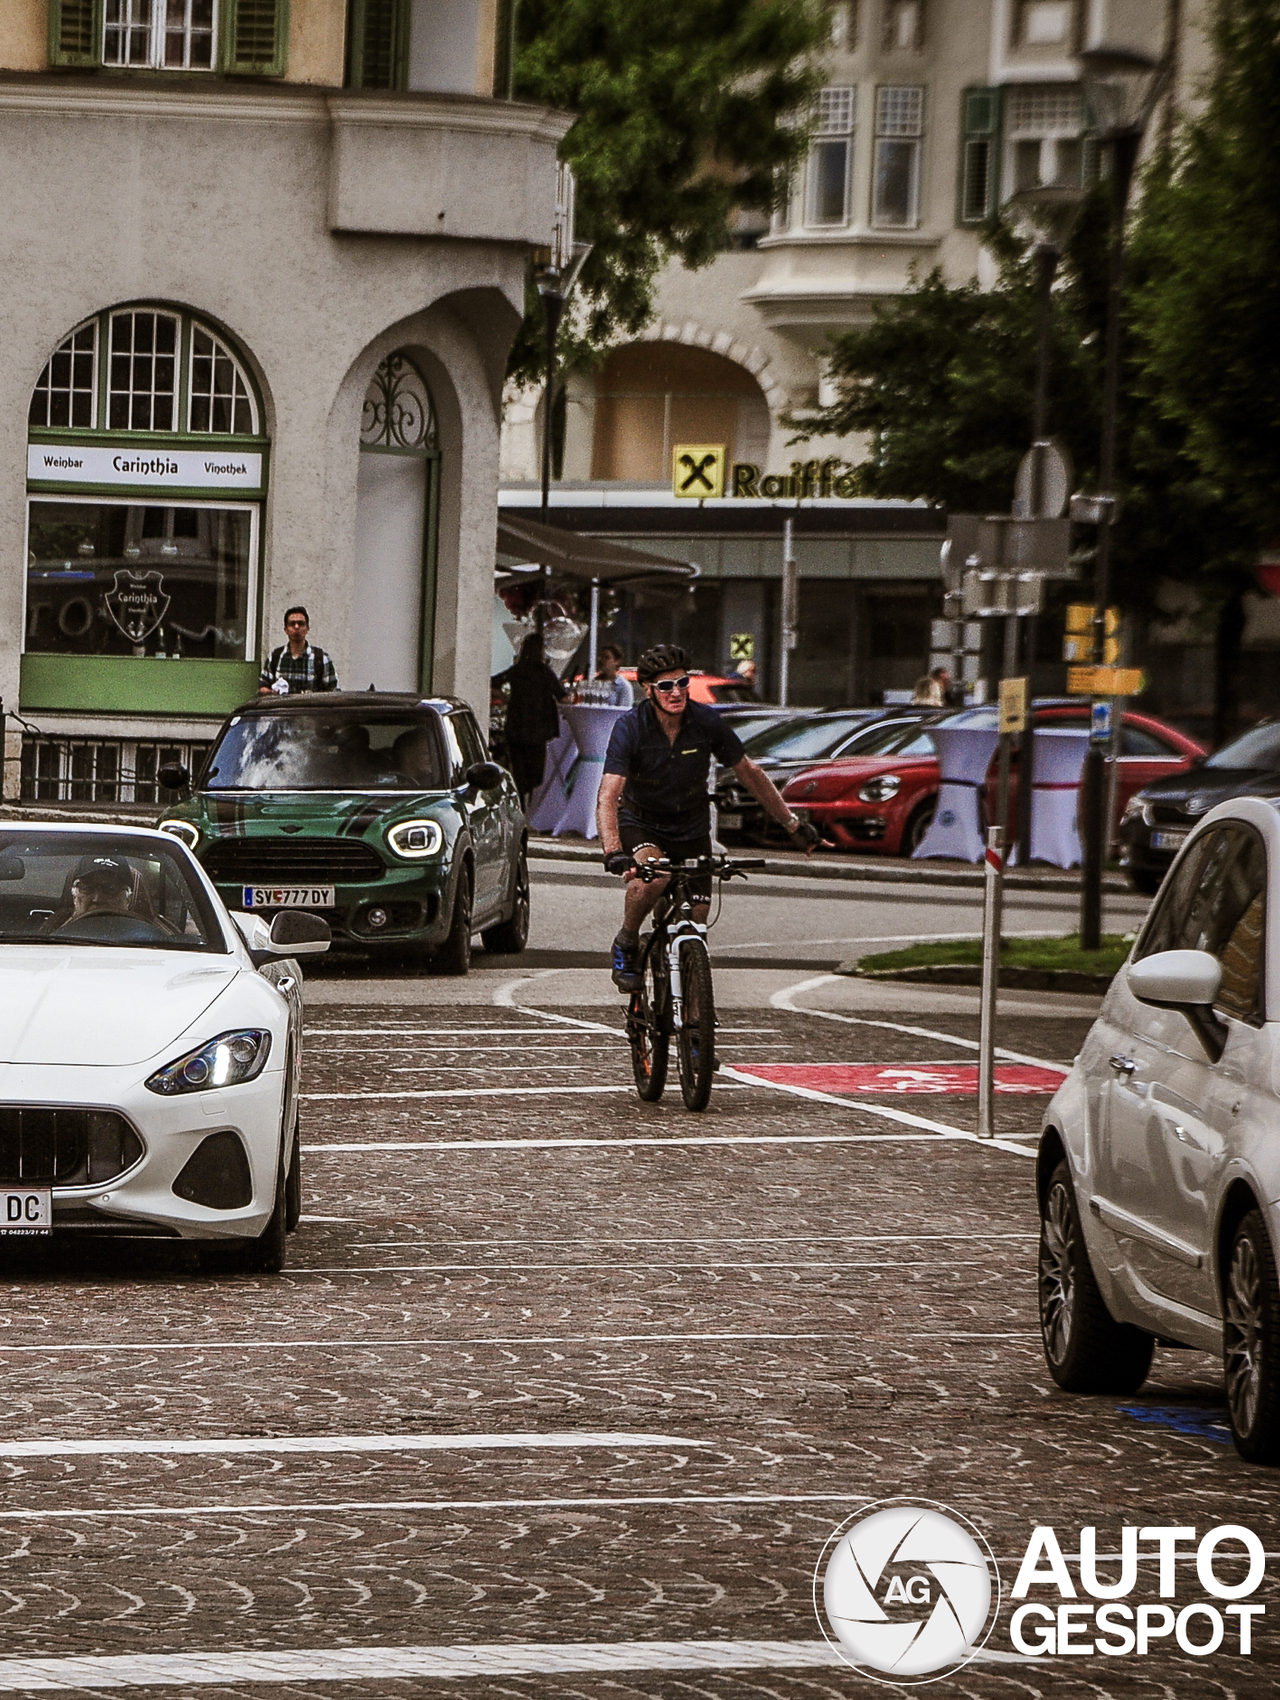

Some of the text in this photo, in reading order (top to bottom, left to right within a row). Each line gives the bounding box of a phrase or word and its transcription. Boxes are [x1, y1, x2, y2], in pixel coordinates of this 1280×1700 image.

[43, 456, 248, 476] Weinbar Carinthia Vinothek
[117, 592, 158, 605] Carinthia
[255, 890, 273, 905] SV
[282, 890, 310, 904] 777
[311, 890, 329, 904] DY
[6, 1195, 40, 1222] DC
